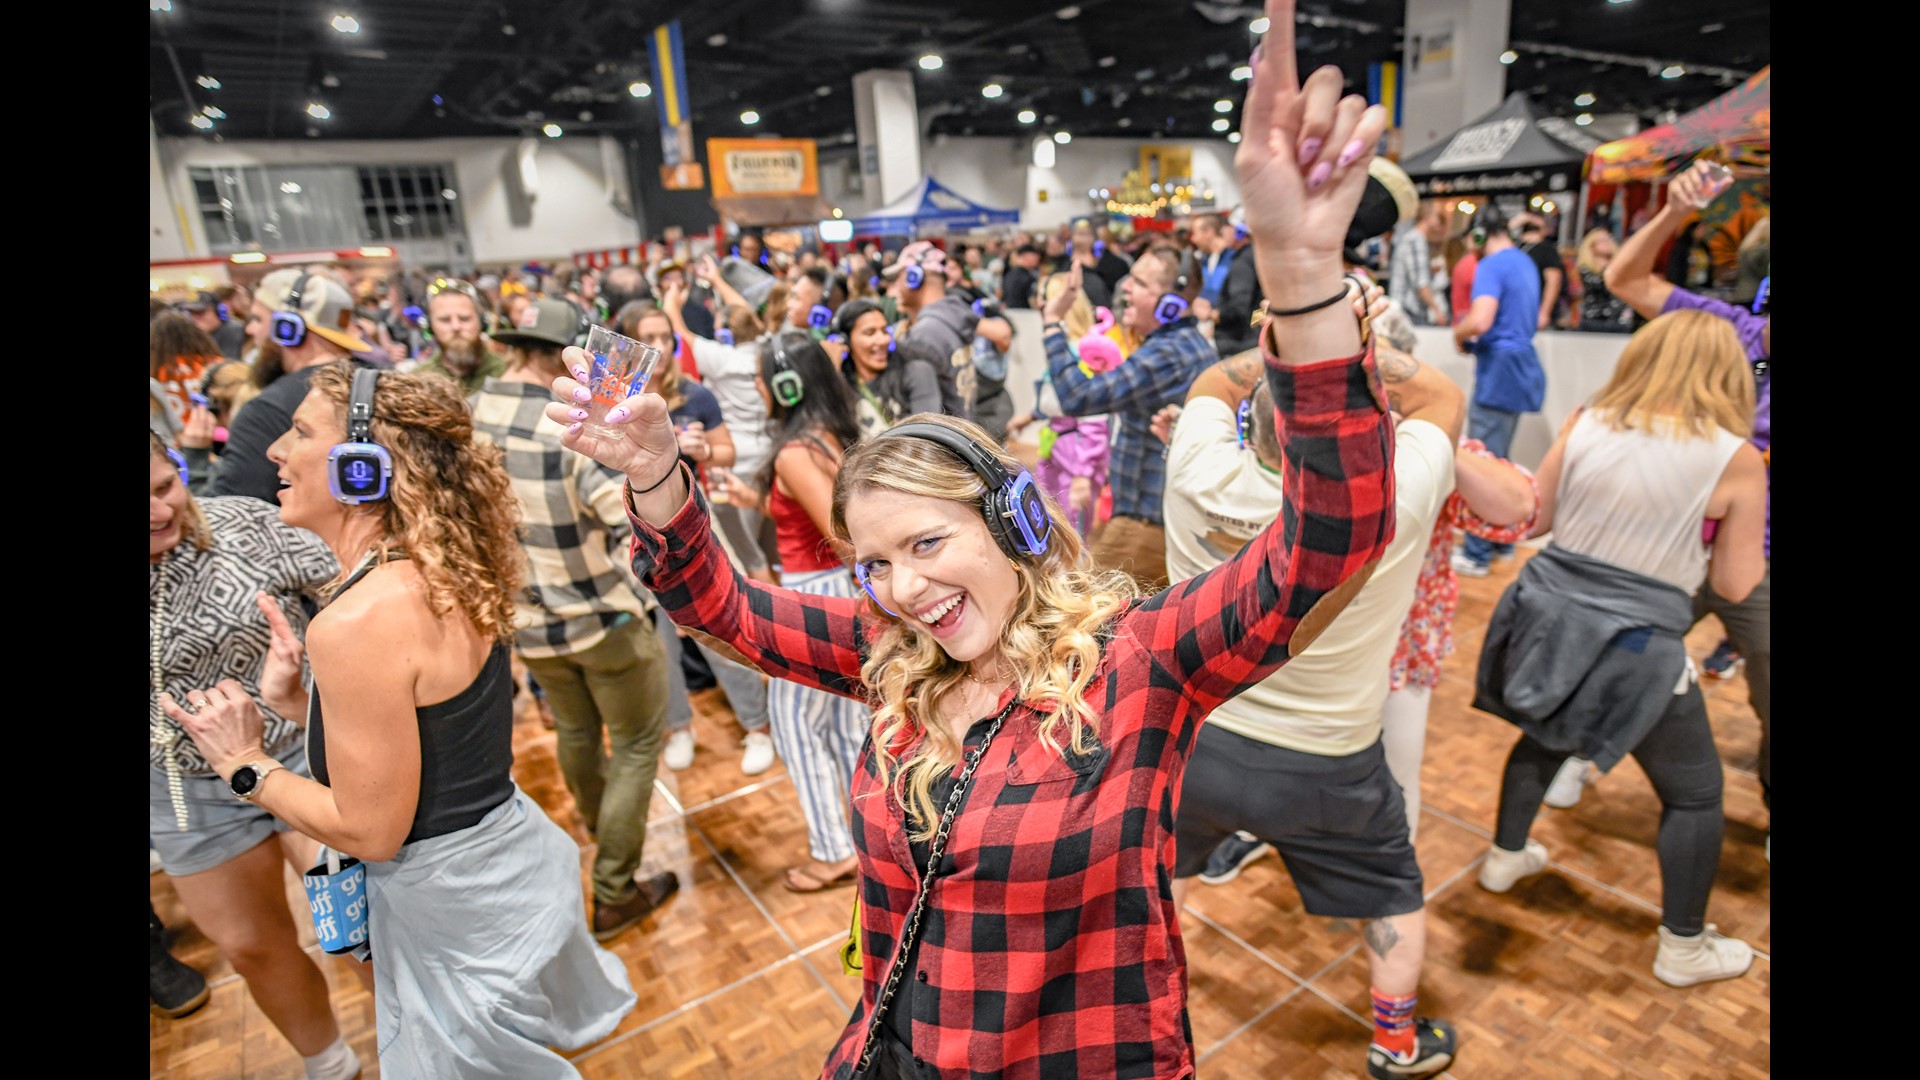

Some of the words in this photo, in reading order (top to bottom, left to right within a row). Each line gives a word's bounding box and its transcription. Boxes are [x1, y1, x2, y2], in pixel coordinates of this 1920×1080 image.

[1206, 510, 1245, 527] HOSTED
[1248, 521, 1262, 530] BY
[341, 869, 364, 896] go
[310, 890, 333, 916] uff
[346, 895, 366, 922] go
